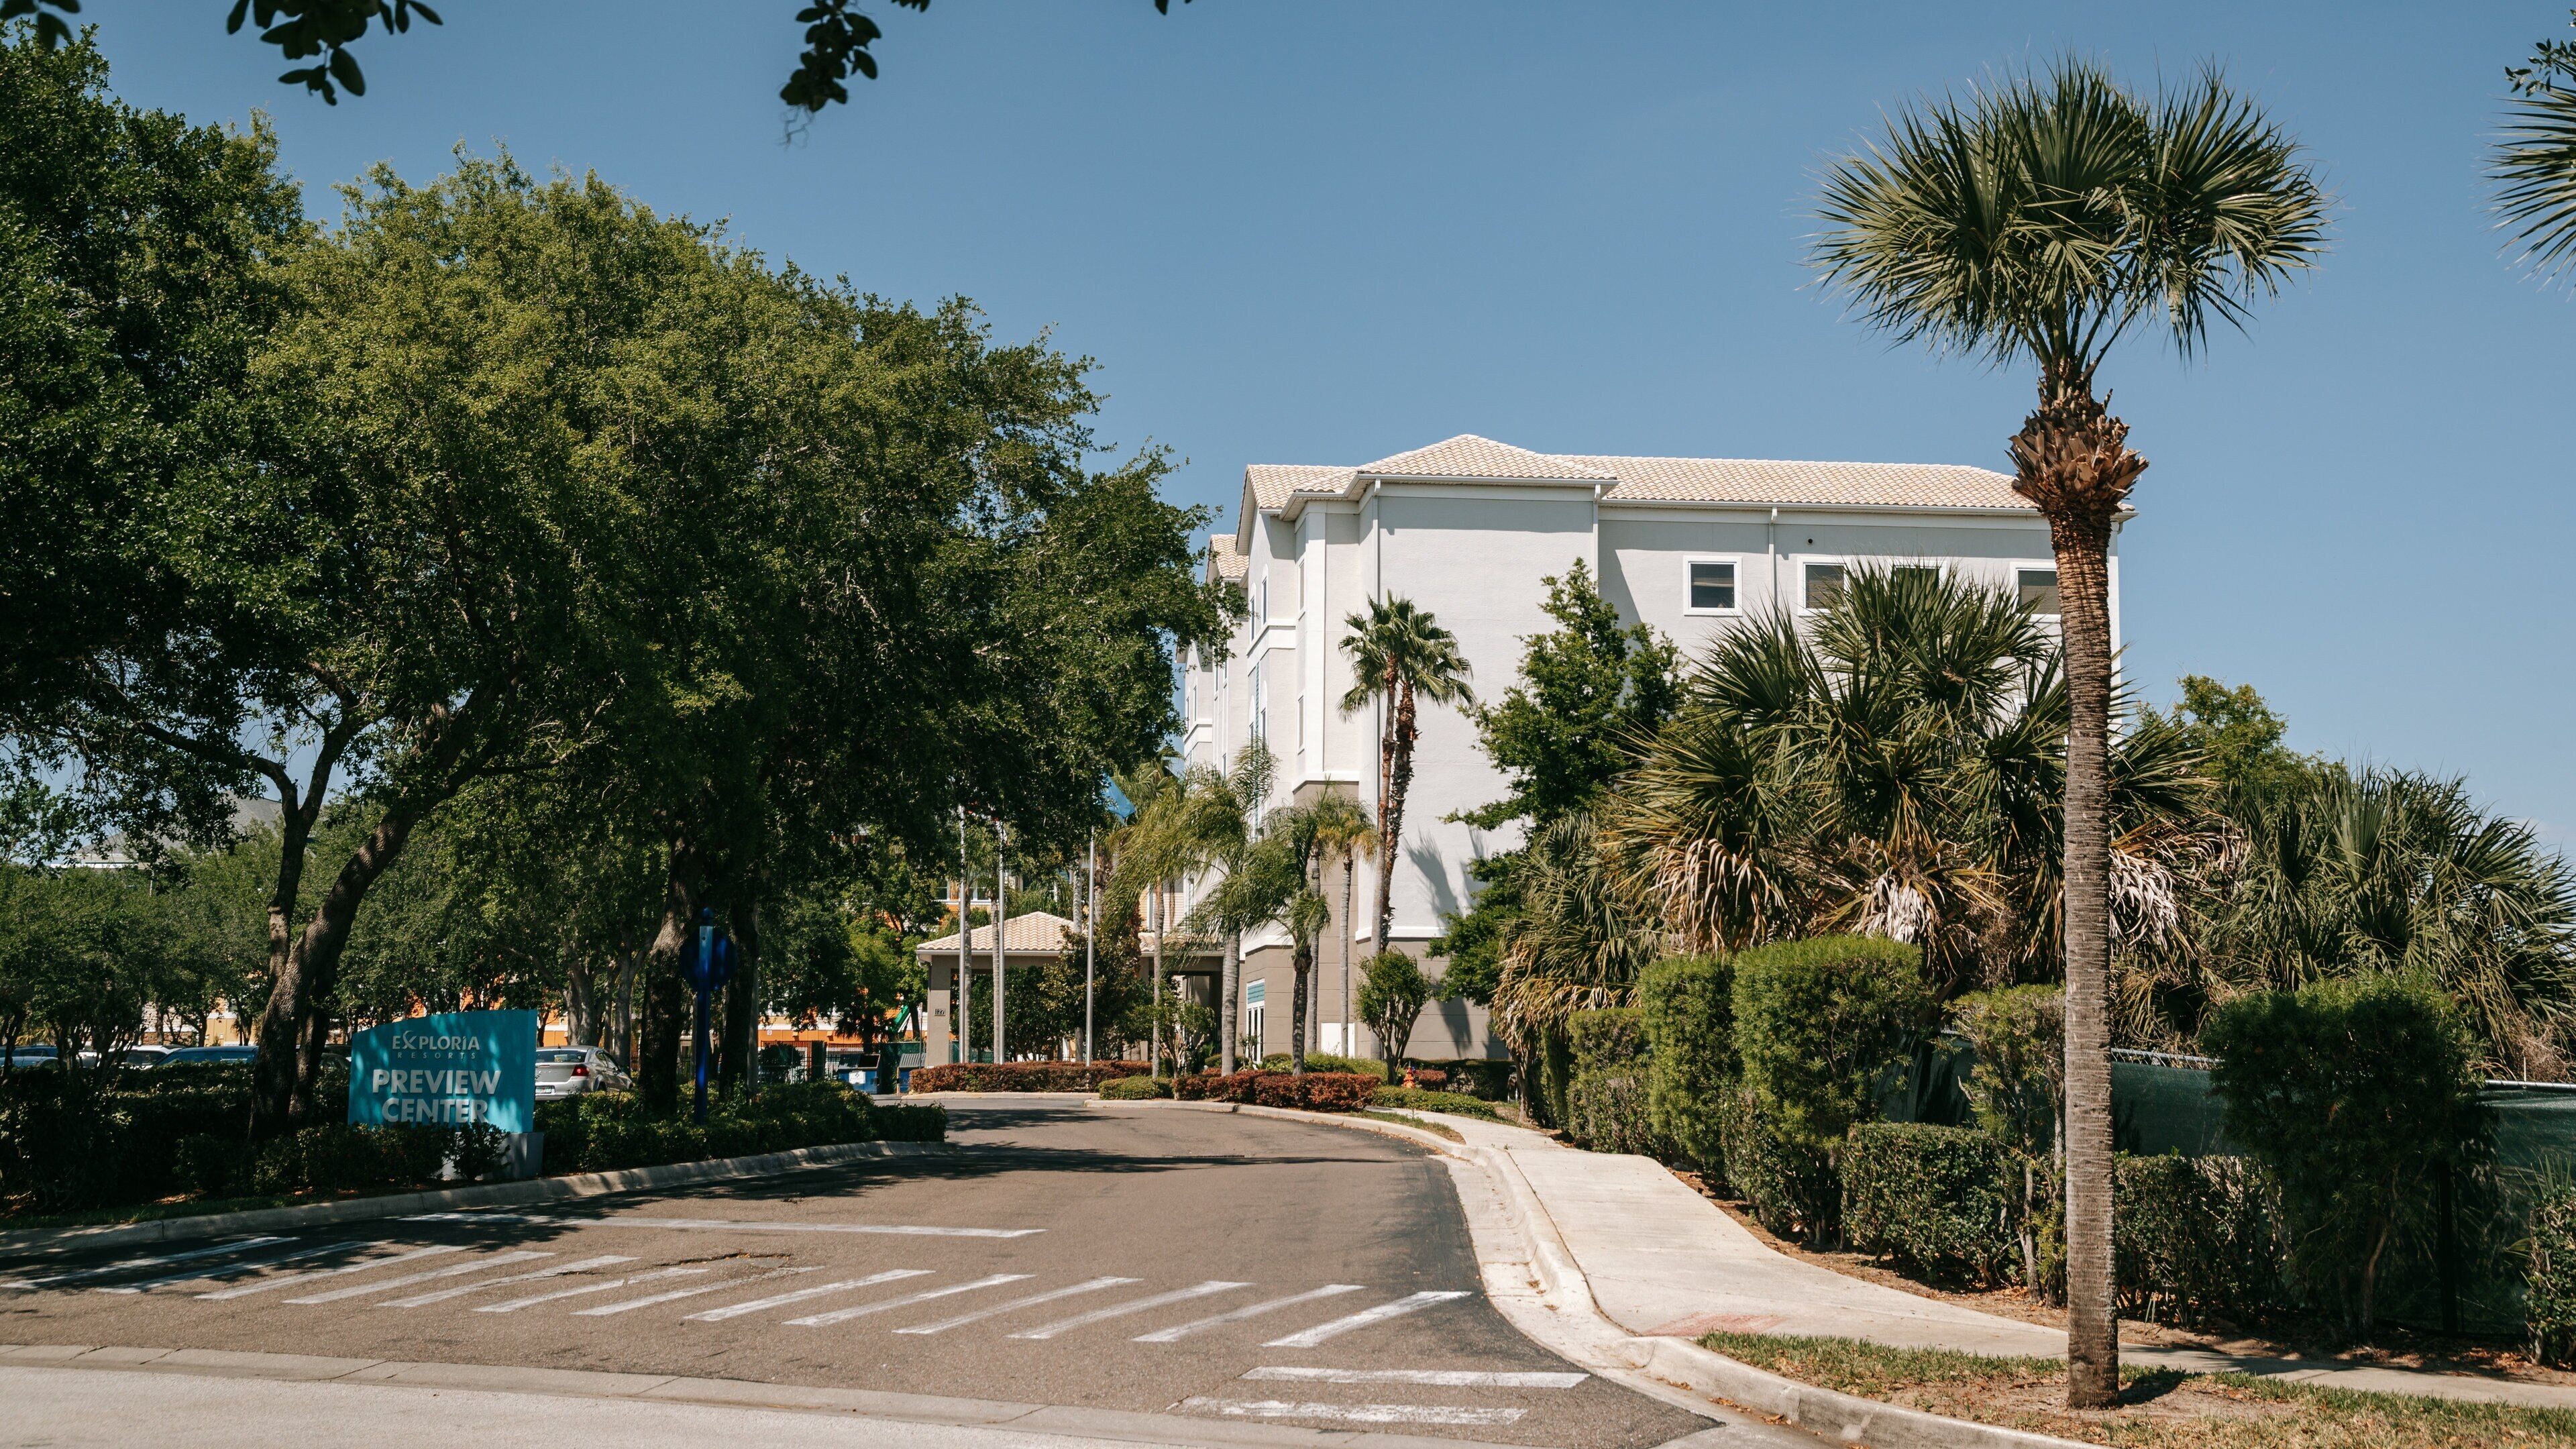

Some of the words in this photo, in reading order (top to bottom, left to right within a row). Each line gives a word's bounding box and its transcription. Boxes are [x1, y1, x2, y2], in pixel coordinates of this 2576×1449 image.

[392, 1030, 480, 1050] EXPLORIA
[372, 1069, 501, 1093] PREVIEW
[382, 1098, 489, 1123] CENTER
